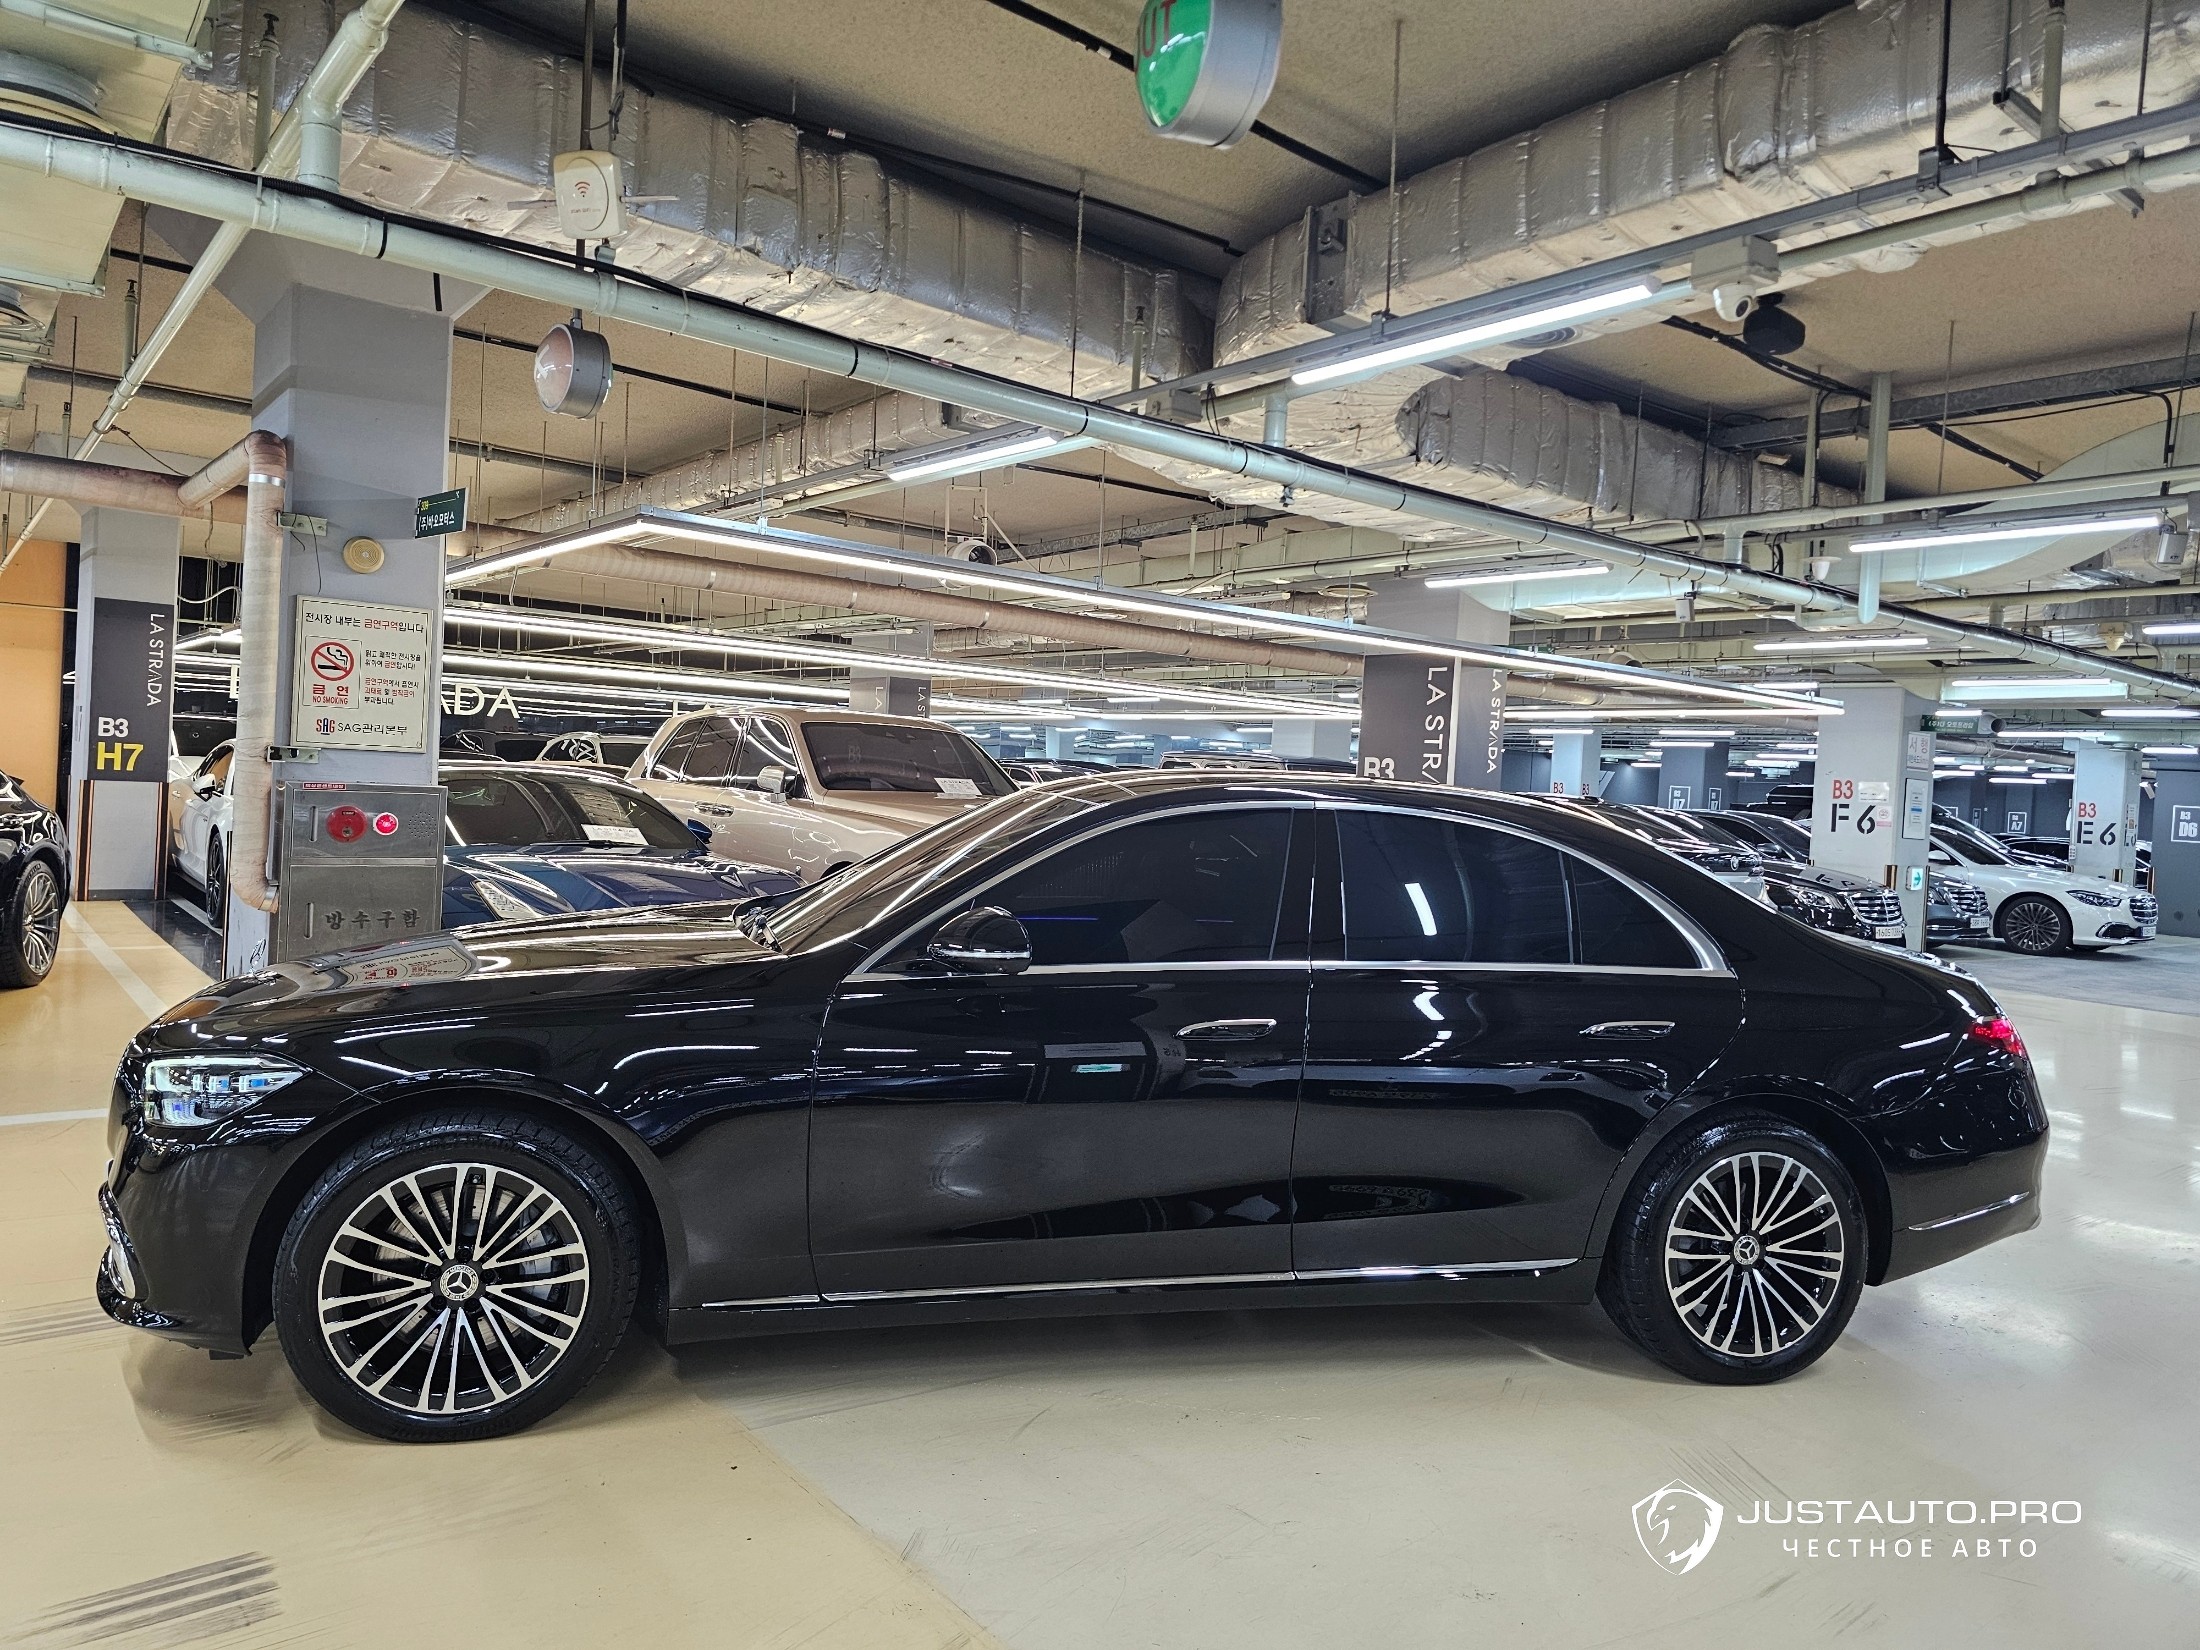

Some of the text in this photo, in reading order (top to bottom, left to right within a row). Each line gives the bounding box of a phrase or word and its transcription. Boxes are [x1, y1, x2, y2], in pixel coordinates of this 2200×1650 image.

[305, 612, 424, 633] 전시장 내부는 금연구역입니다
[146, 613, 165, 707] LA STRADA
[1426, 666, 1448, 706] LA
[312, 696, 349, 705] NO SMOKING
[97, 716, 129, 738] B3
[316, 718, 336, 735] SAG
[1486, 668, 1503, 774] LA STRADA
[96, 741, 144, 772] H7
[1363, 756, 1395, 779] B3
[1553, 782, 1564, 794] B3
[1582, 783, 1590, 795] B3
[1832, 779, 1854, 800] B3
[2078, 802, 2097, 818] B3
[2179, 811, 2191, 820] B3
[2010, 821, 2023, 831] A7
[2178, 821, 2198, 838] D6
